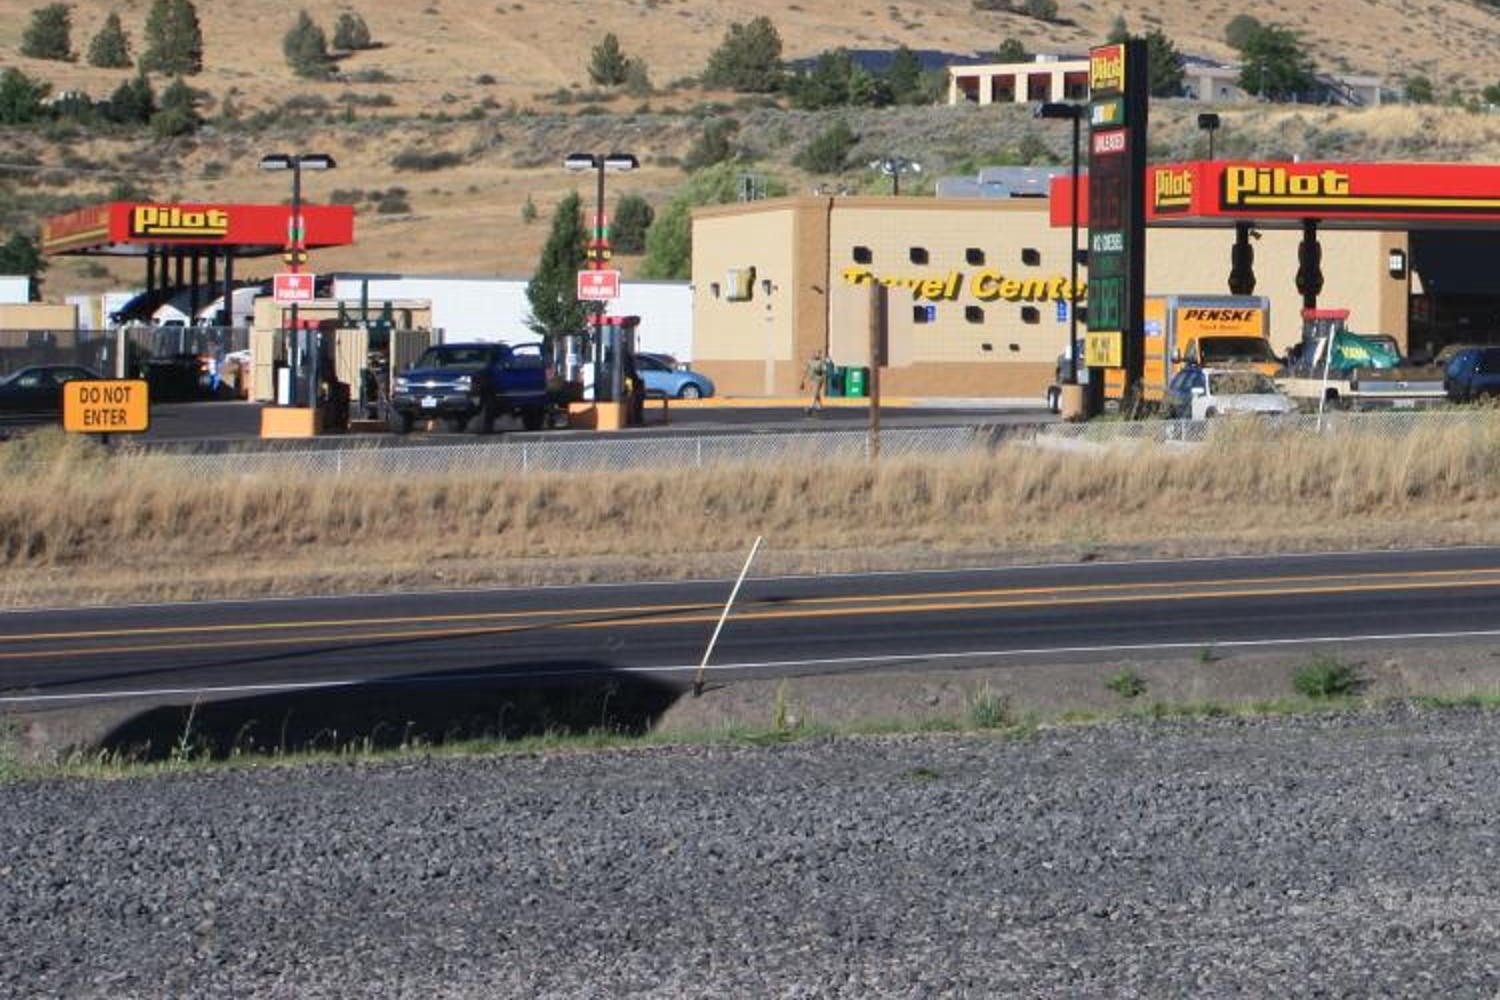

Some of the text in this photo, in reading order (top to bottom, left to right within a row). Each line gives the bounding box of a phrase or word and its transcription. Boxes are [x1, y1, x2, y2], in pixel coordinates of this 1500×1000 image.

[1092, 55, 1121, 89] Pilot
[1155, 169, 1191, 206] Pilot
[1226, 166, 1350, 204] Pilot
[134, 205, 228, 233] Pilot
[970, 267, 1087, 301] Cente
[1183, 309, 1255, 321] PENSKE
[79, 386, 131, 404] DO NOT
[83, 408, 127, 425] ENTER
